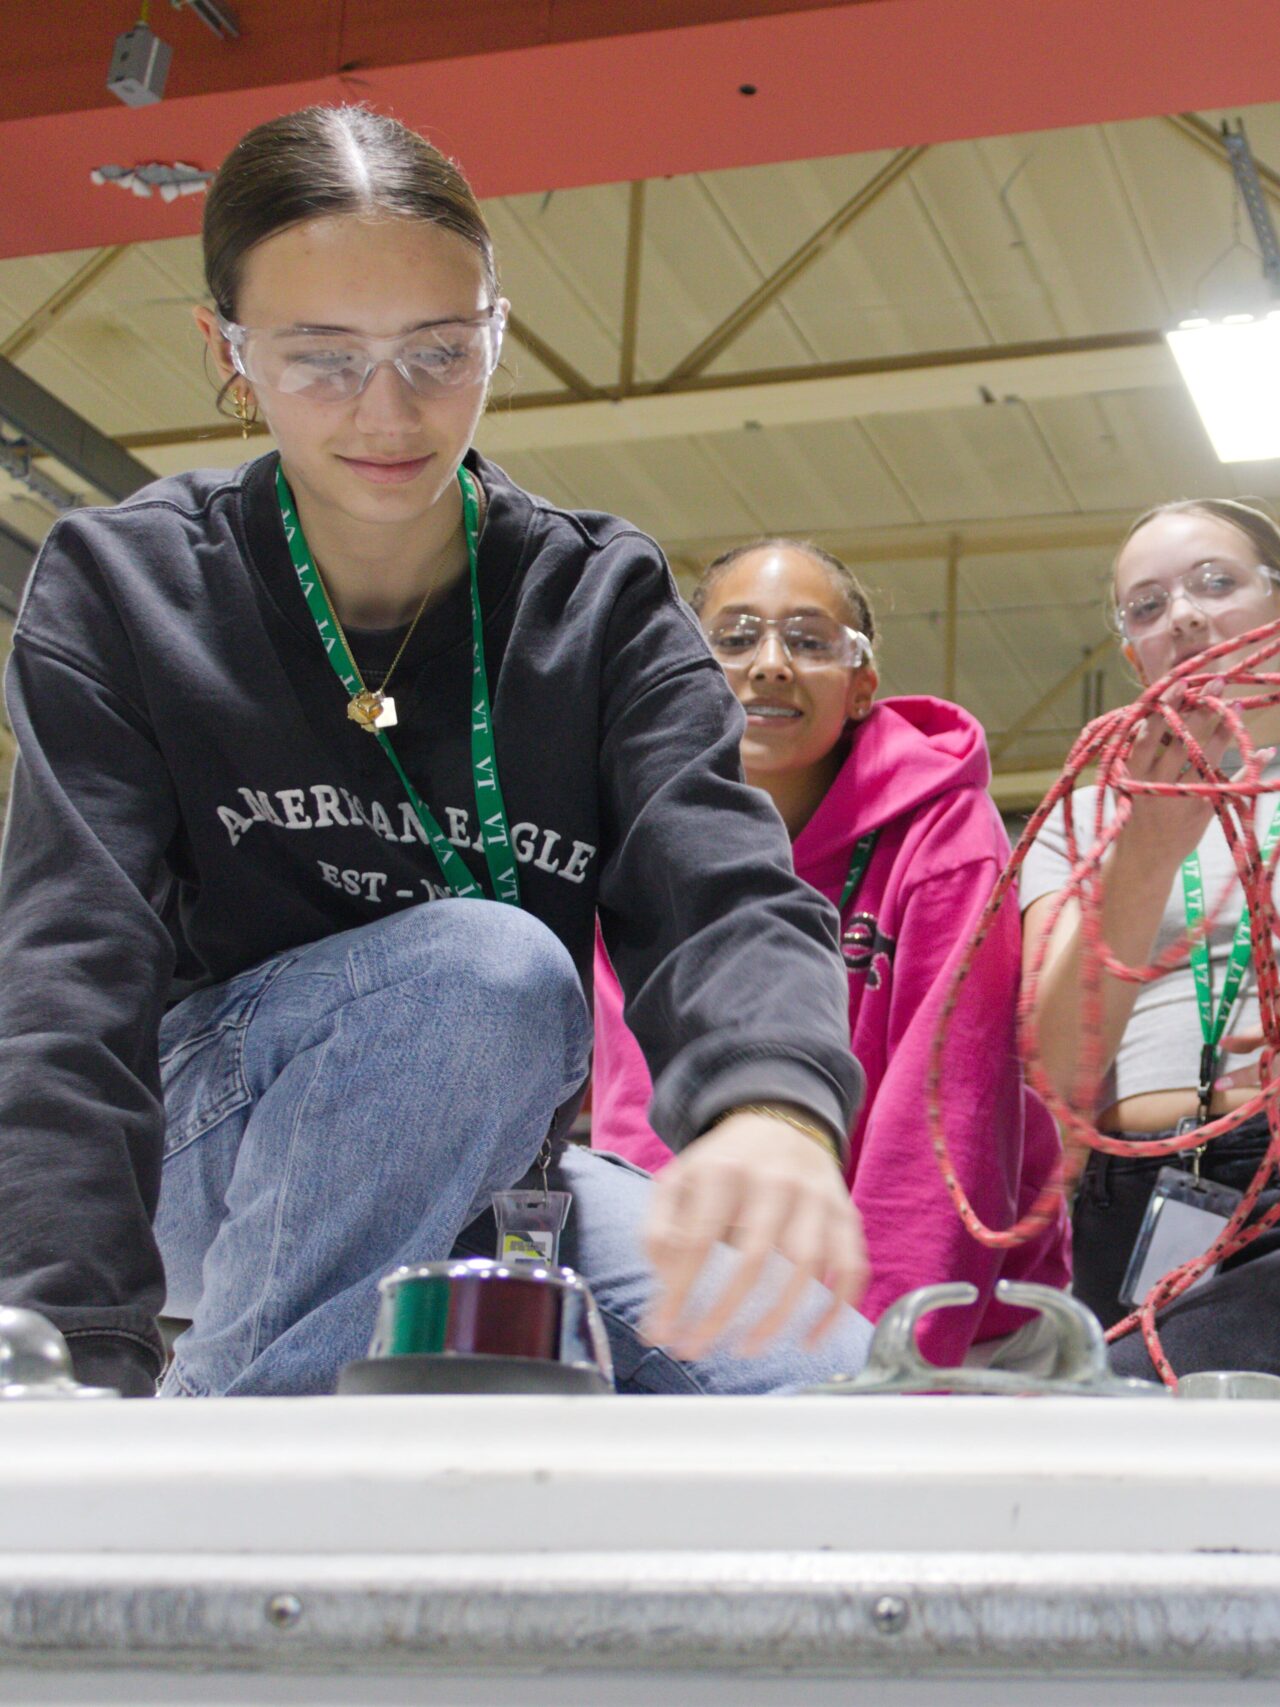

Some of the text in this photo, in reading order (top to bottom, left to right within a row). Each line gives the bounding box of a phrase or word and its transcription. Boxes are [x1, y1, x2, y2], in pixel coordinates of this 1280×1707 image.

[472, 699, 488, 734] VT
[475, 755, 496, 790] VT
[445, 806, 597, 885] EGLE
[484, 811, 509, 847] VT
[317, 860, 387, 903] EST
[497, 866, 519, 901] VT
